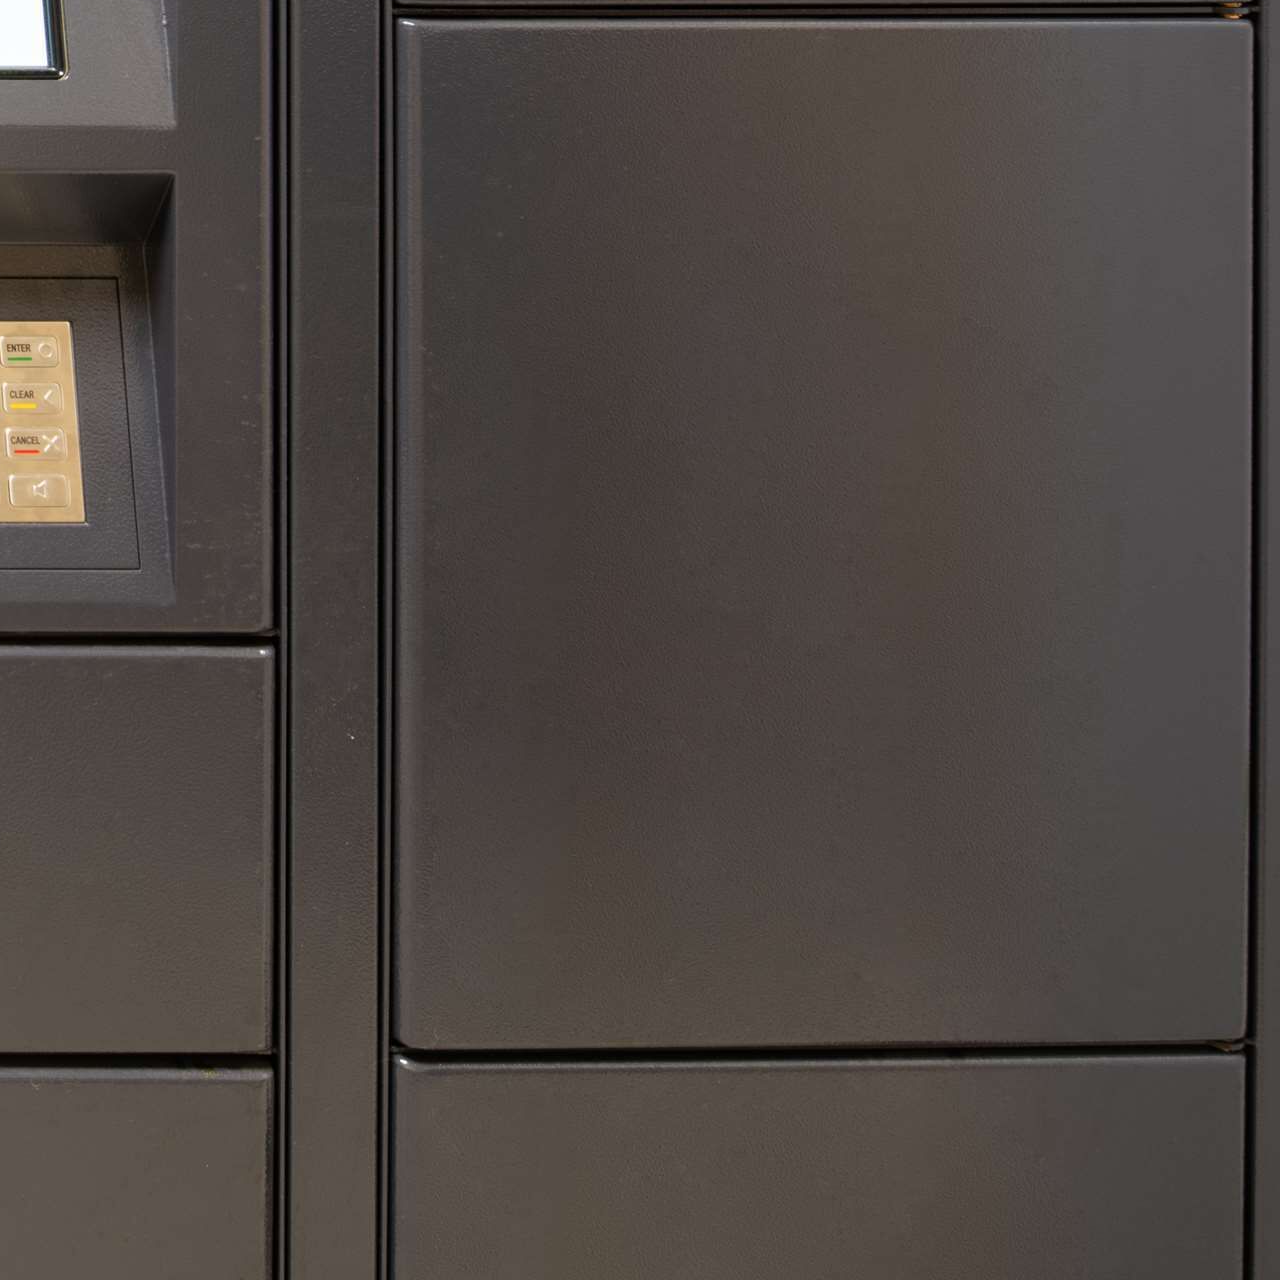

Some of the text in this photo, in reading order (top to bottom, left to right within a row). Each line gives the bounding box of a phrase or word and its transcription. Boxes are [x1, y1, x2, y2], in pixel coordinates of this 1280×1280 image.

[6, 344, 32, 352] ENTER
[9, 390, 35, 399] CLEAR
[10, 435, 41, 445] CANCEL
